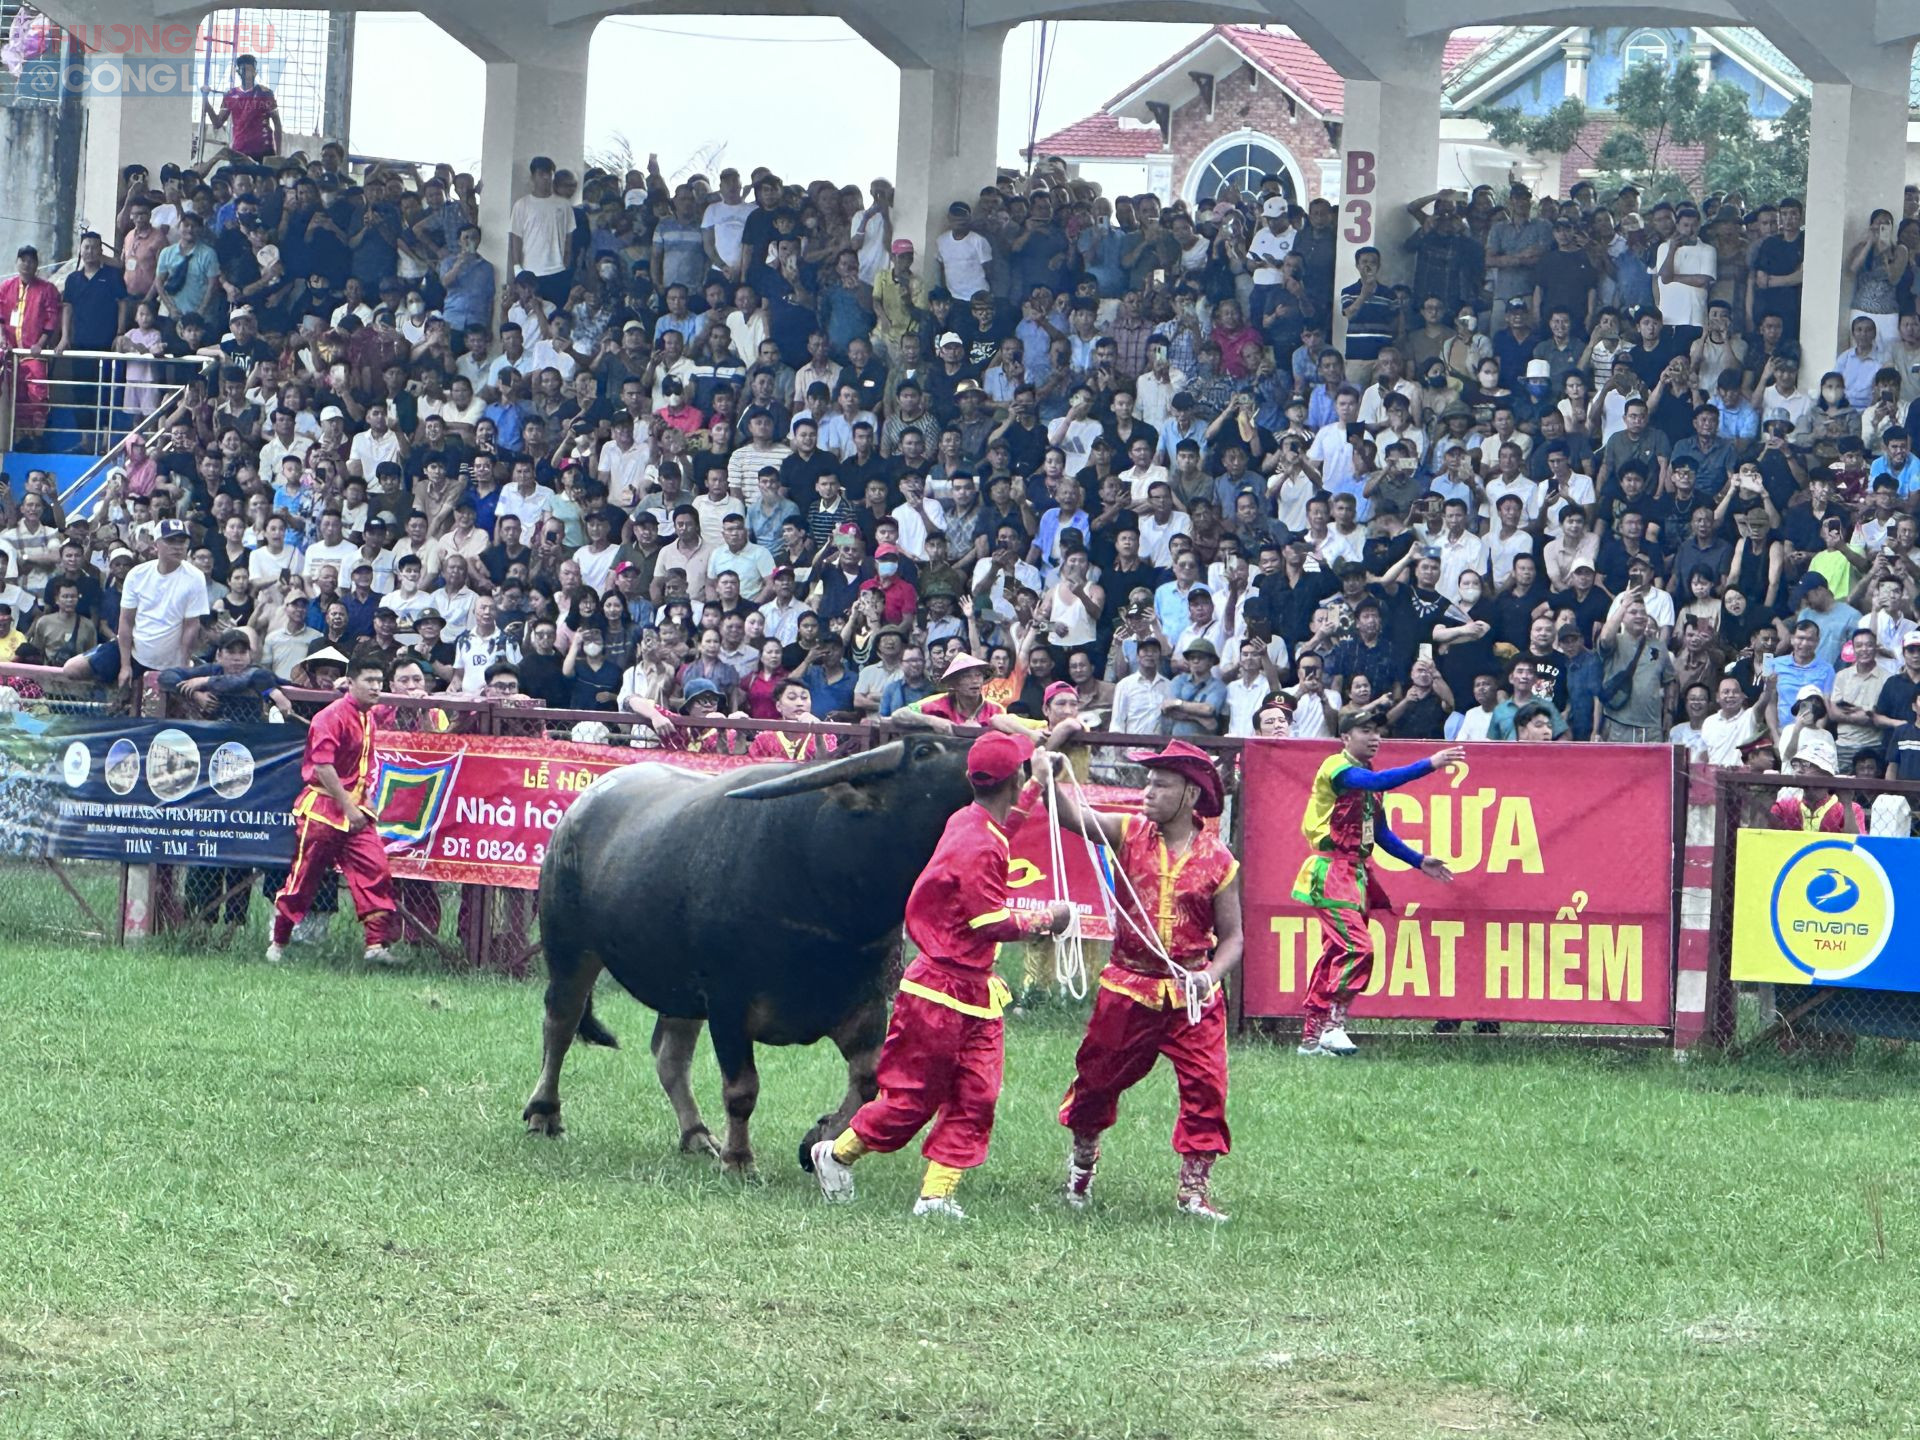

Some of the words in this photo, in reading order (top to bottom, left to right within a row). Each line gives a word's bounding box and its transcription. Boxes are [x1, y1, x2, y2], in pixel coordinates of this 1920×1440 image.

[1536, 663, 1560, 677] NZO
[523, 761, 550, 789] LỄ
[165, 806, 228, 823] PROPERTY
[456, 796, 516, 828] Nhà
[524, 800, 563, 830] hà
[1371, 760, 1545, 874] CỬA
[442, 836, 471, 858] ĐT:
[476, 838, 527, 863] 0826
[532, 843, 545, 865] 3
[1485, 890, 1643, 1002] HIỂM
[1813, 939, 1847, 951] TAXI
